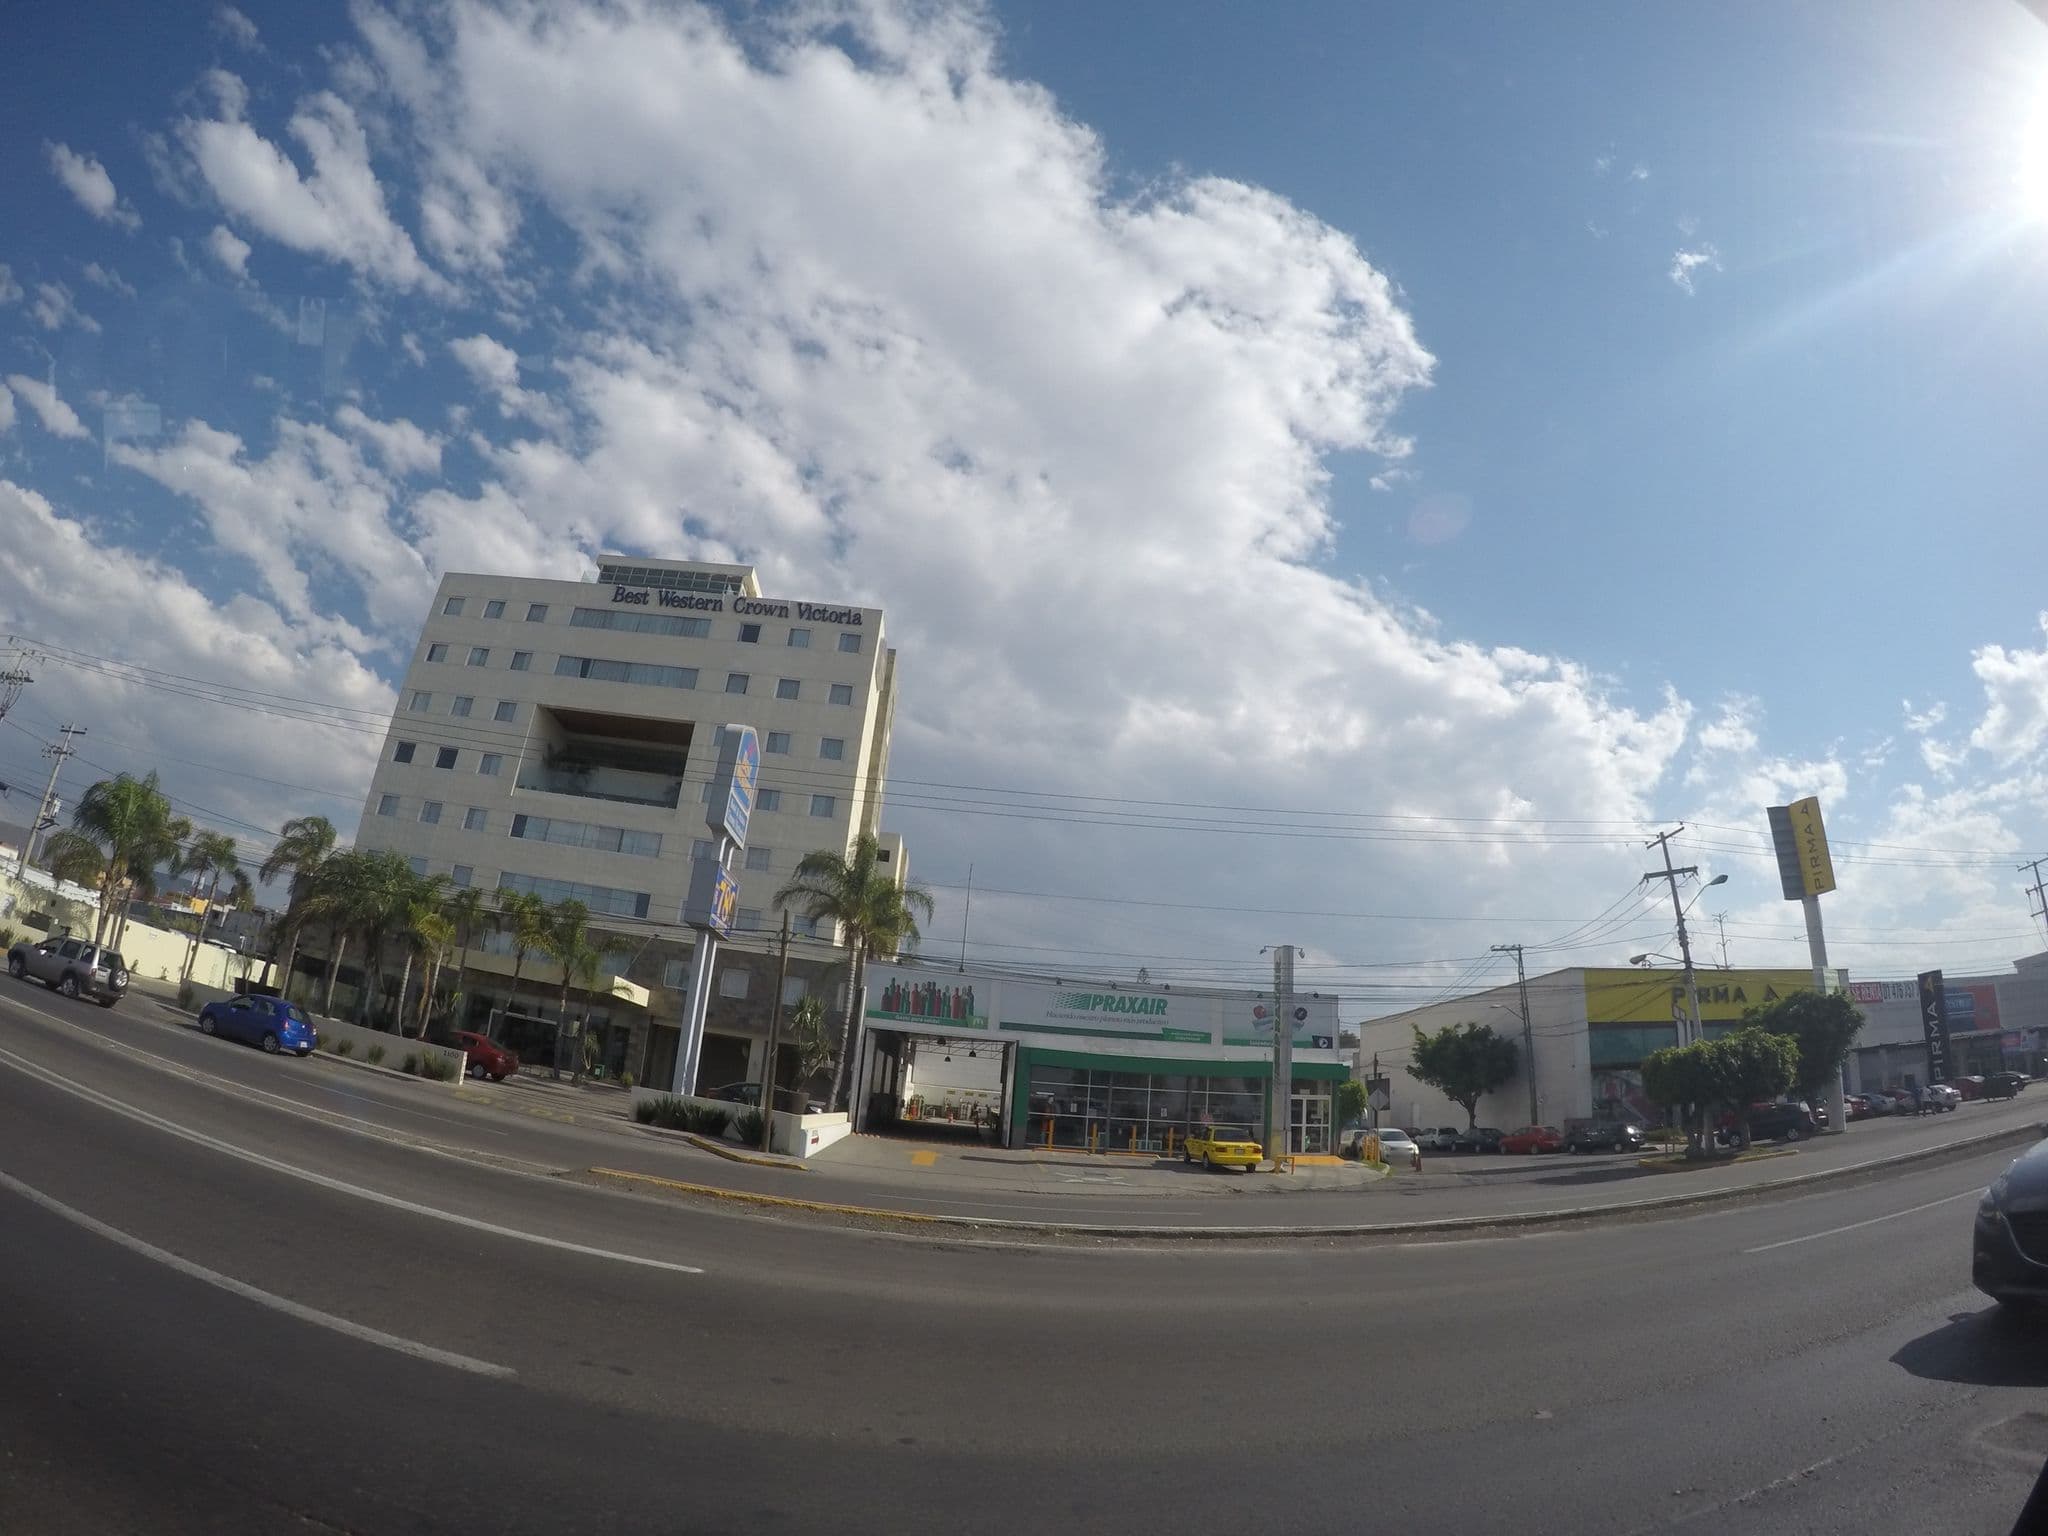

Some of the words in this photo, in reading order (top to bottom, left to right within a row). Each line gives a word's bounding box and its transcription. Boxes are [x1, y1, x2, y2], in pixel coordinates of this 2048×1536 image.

[612, 586, 650, 605] Best
[658, 590, 723, 612] Western
[733, 597, 789, 618] Crown
[797, 602, 863, 625] Victoria
[1804, 823, 1825, 890] PIRMA
[1090, 993, 1169, 1015] PRAXAIR
[1671, 986, 1747, 1003] PRMA
[1926, 1001, 1945, 1082] PIRMA
